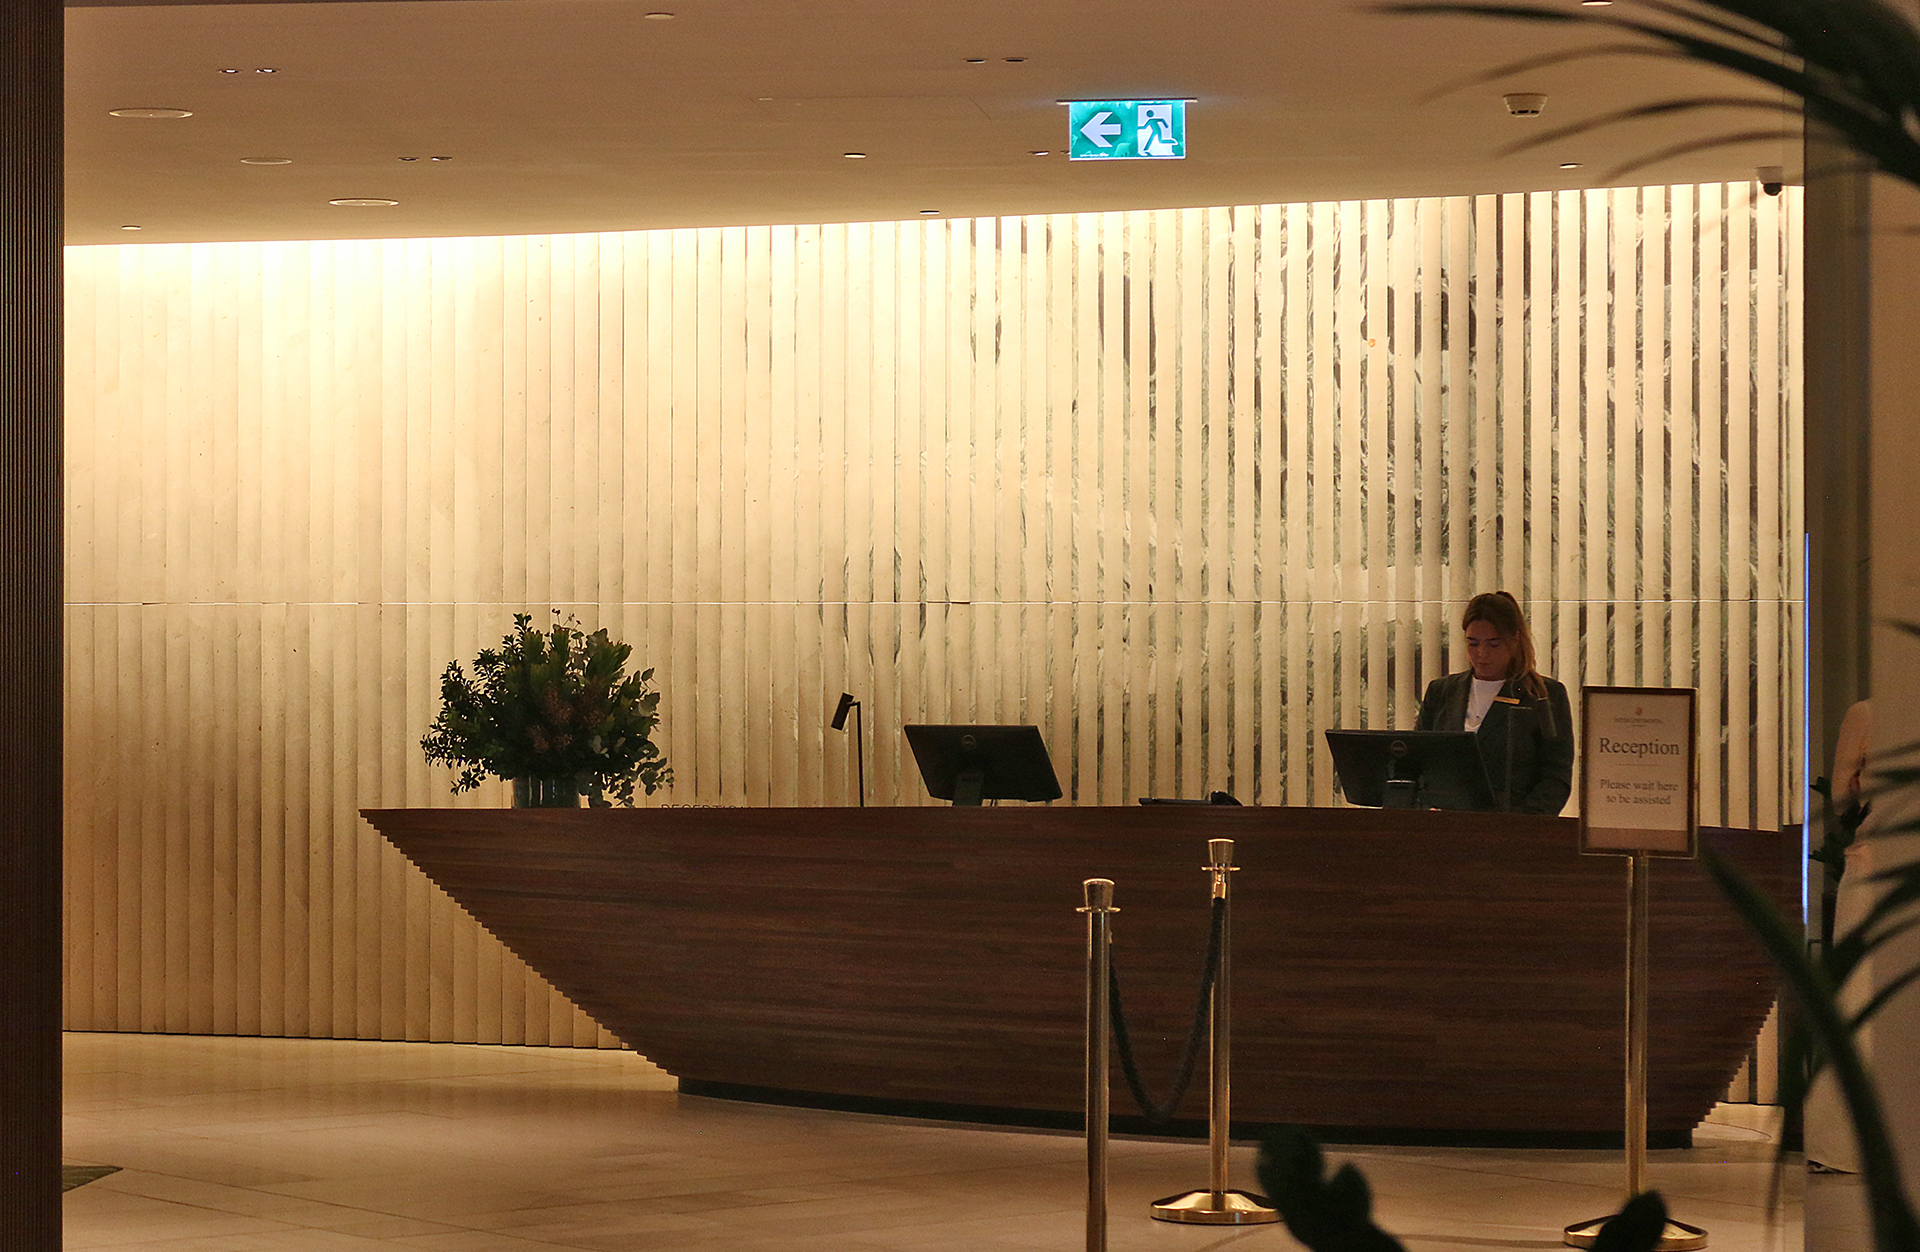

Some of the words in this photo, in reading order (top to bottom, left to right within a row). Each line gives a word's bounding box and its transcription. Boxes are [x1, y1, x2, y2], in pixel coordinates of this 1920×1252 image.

[1599, 737, 1680, 758] Reception
[1600, 779, 1631, 789] Please
[1634, 780, 1655, 790] wait
[1657, 780, 1679, 791] here
[1606, 795, 1617, 804] to
[1619, 794, 1631, 804] be
[1633, 795, 1672, 805] assisted
